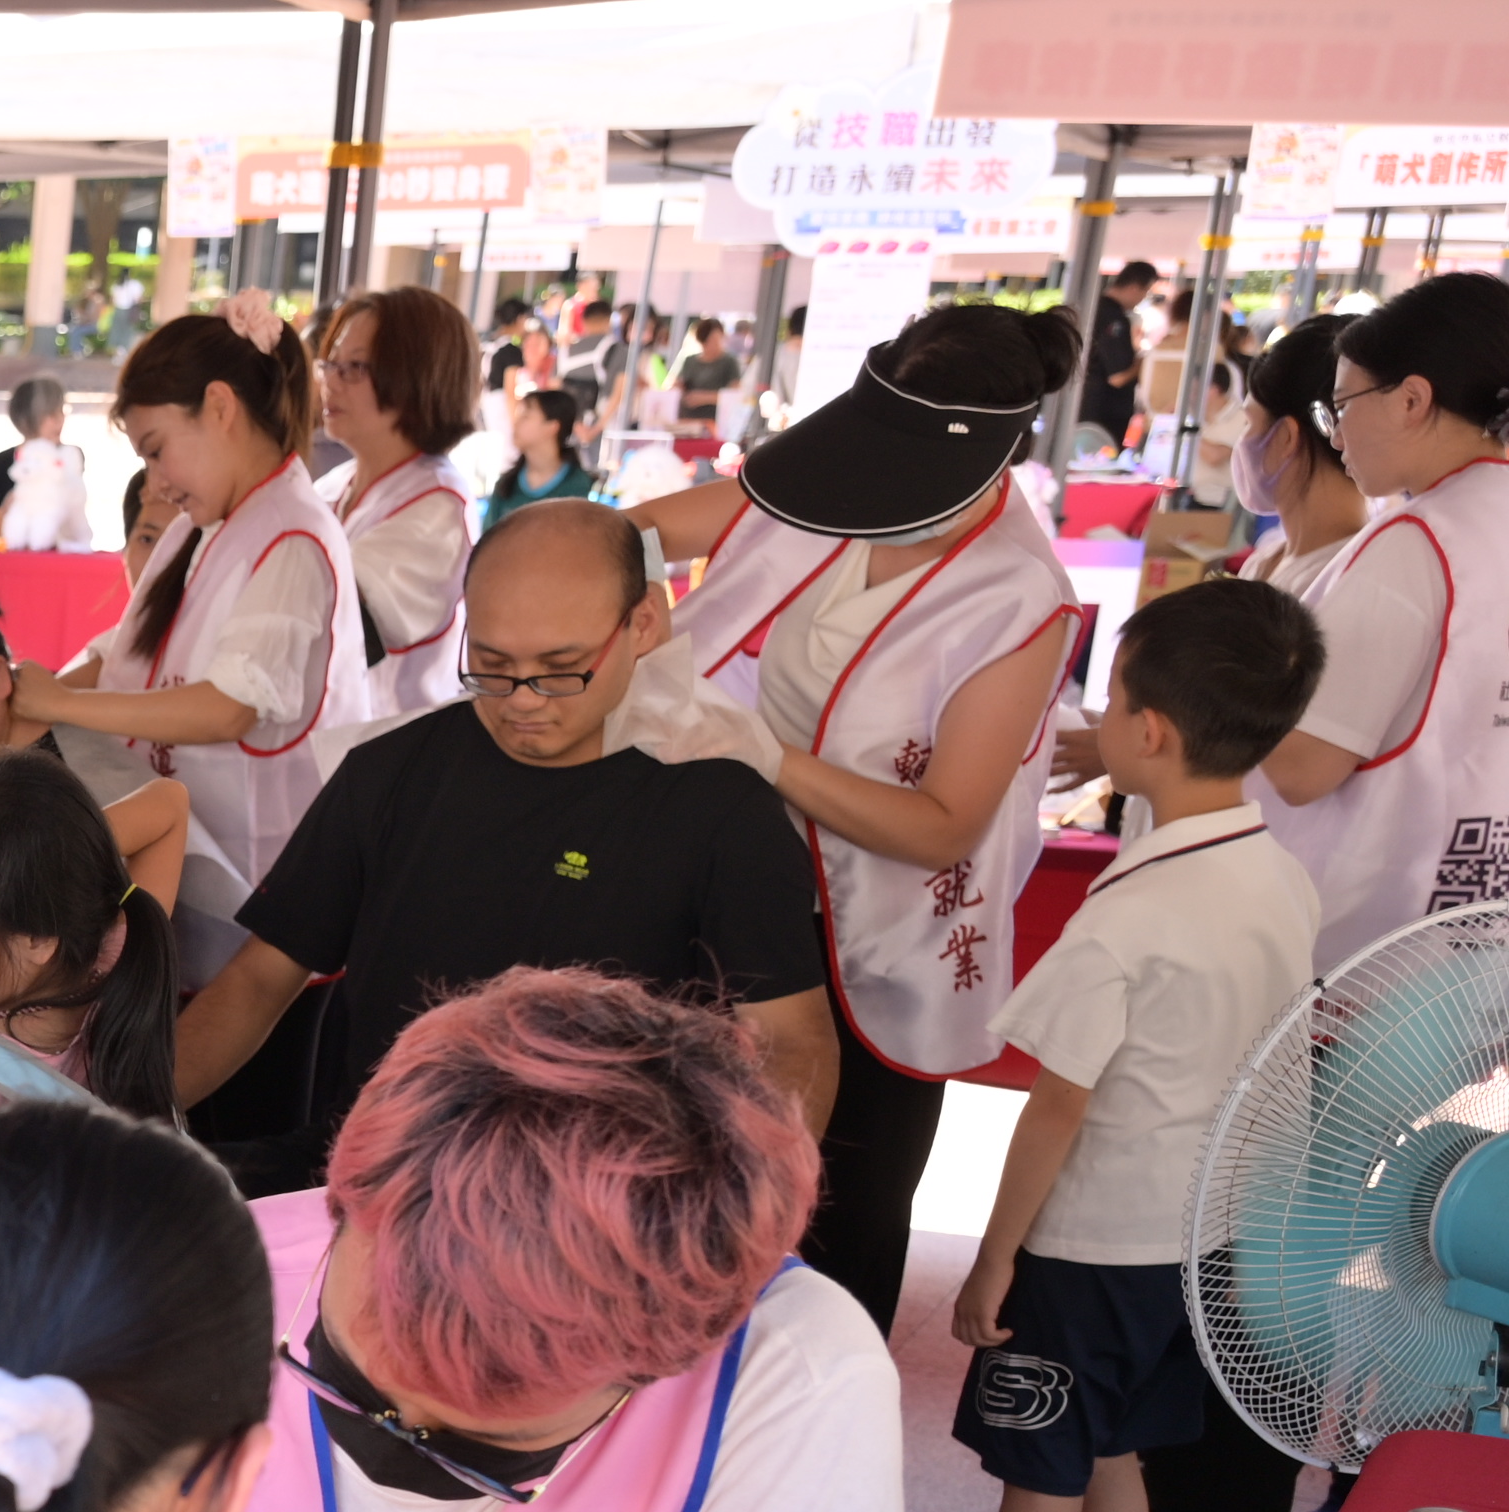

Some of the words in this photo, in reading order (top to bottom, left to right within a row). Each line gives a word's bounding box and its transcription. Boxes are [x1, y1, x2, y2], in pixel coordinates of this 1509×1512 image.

[793, 110, 998, 150] 從技職出發
[770, 158, 1012, 196] 打造永續未來
